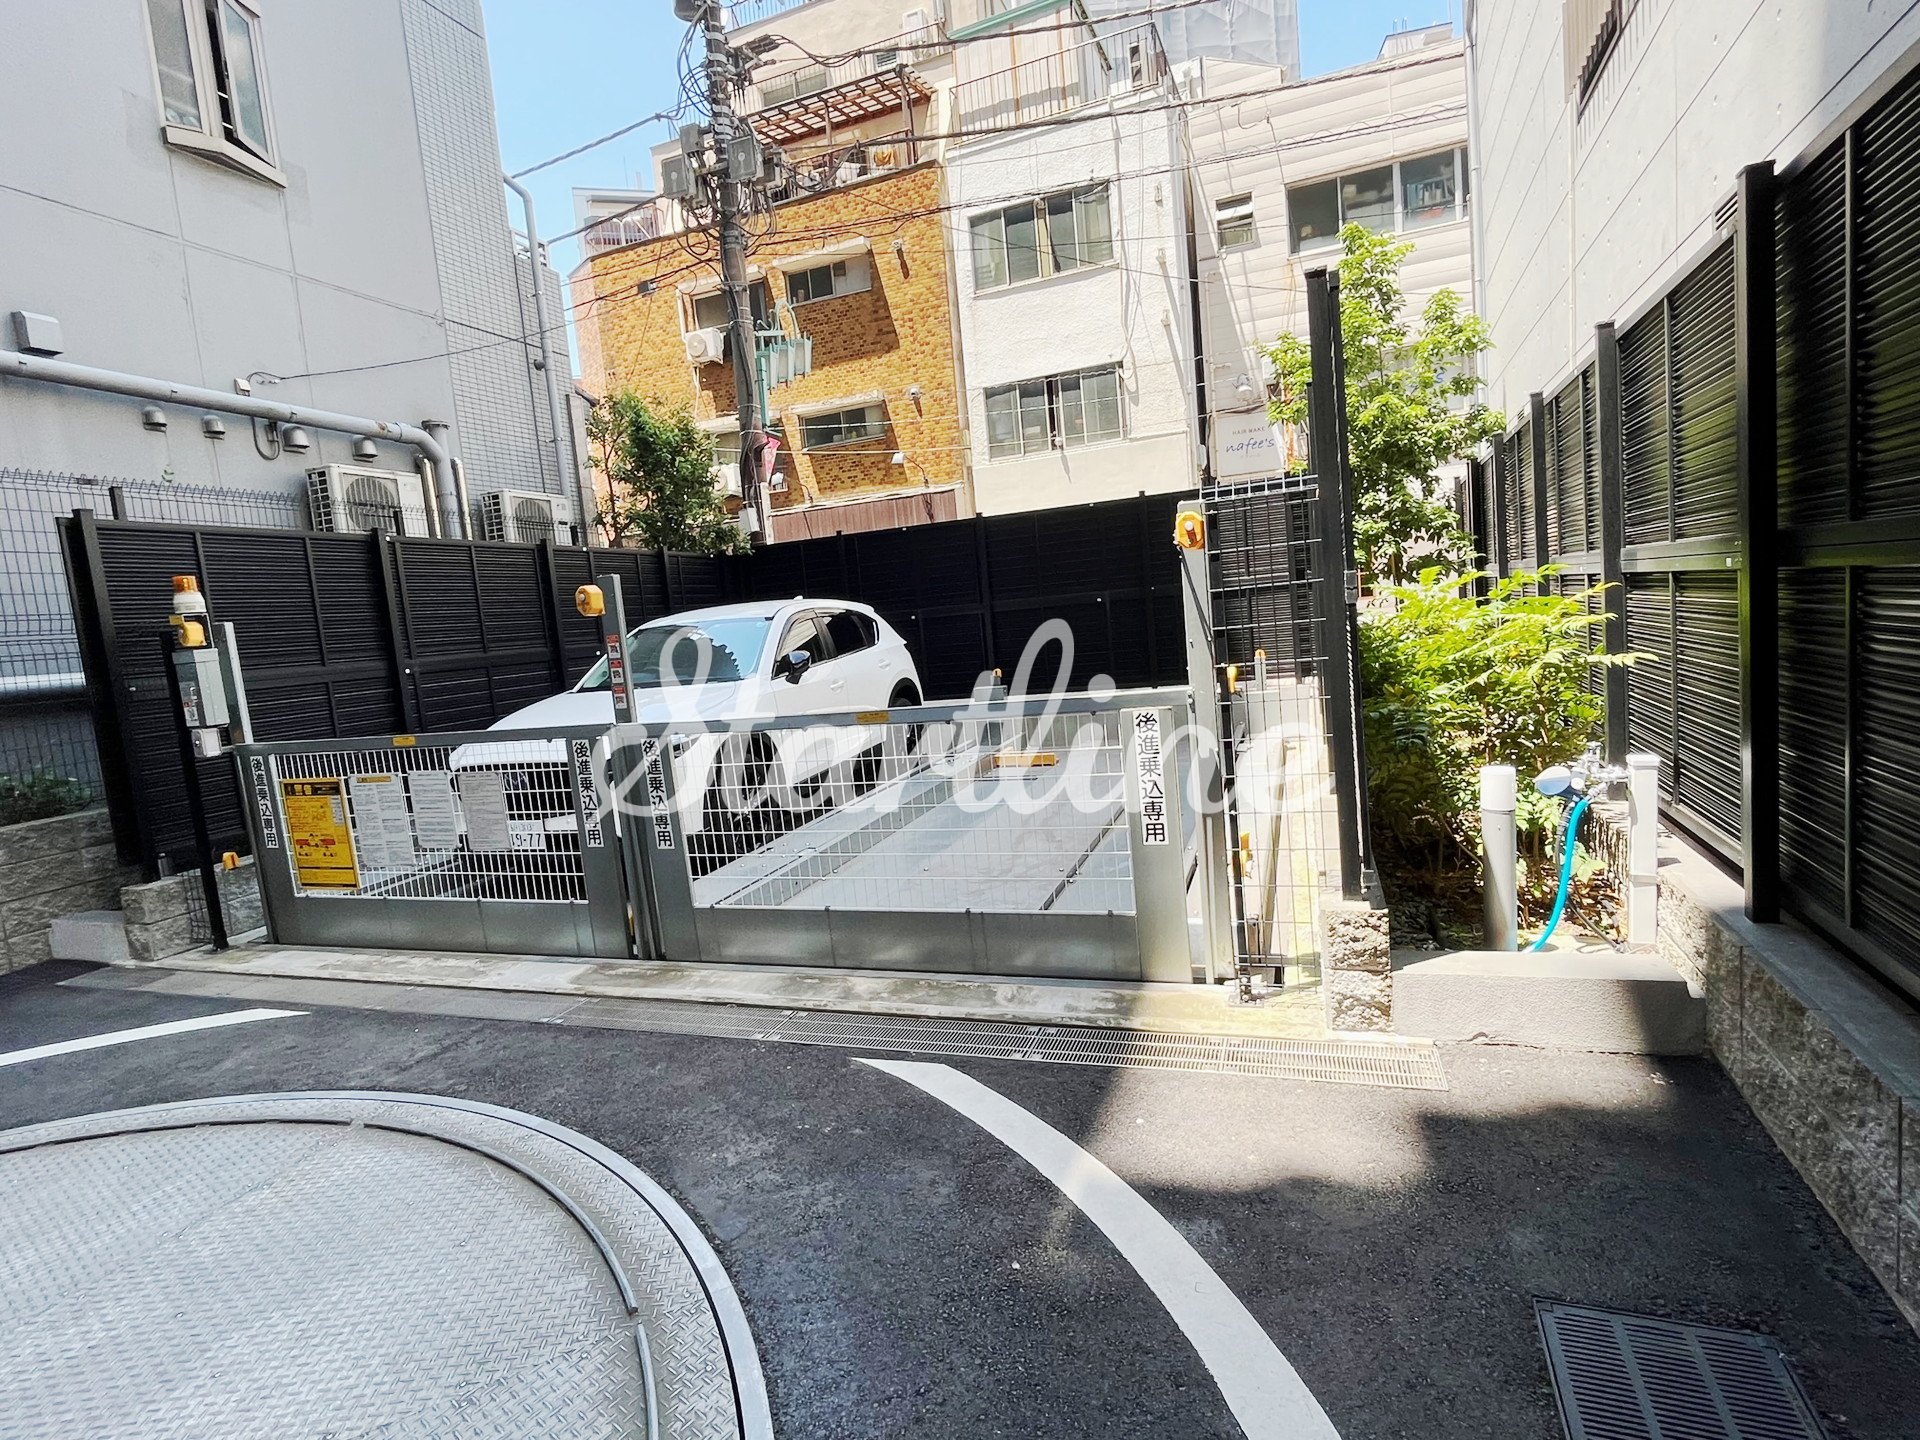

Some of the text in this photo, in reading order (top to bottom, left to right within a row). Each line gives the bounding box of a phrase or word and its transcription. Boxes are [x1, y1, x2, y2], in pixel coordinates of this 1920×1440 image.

[1225, 437, 1275, 454] nafee's
[252, 757, 277, 847] 後進乗込専用
[574, 741, 602, 846] 後進乗込専用
[643, 740, 673, 847] 後進乗込専用
[1135, 712, 1166, 842] 後進乗込専用
